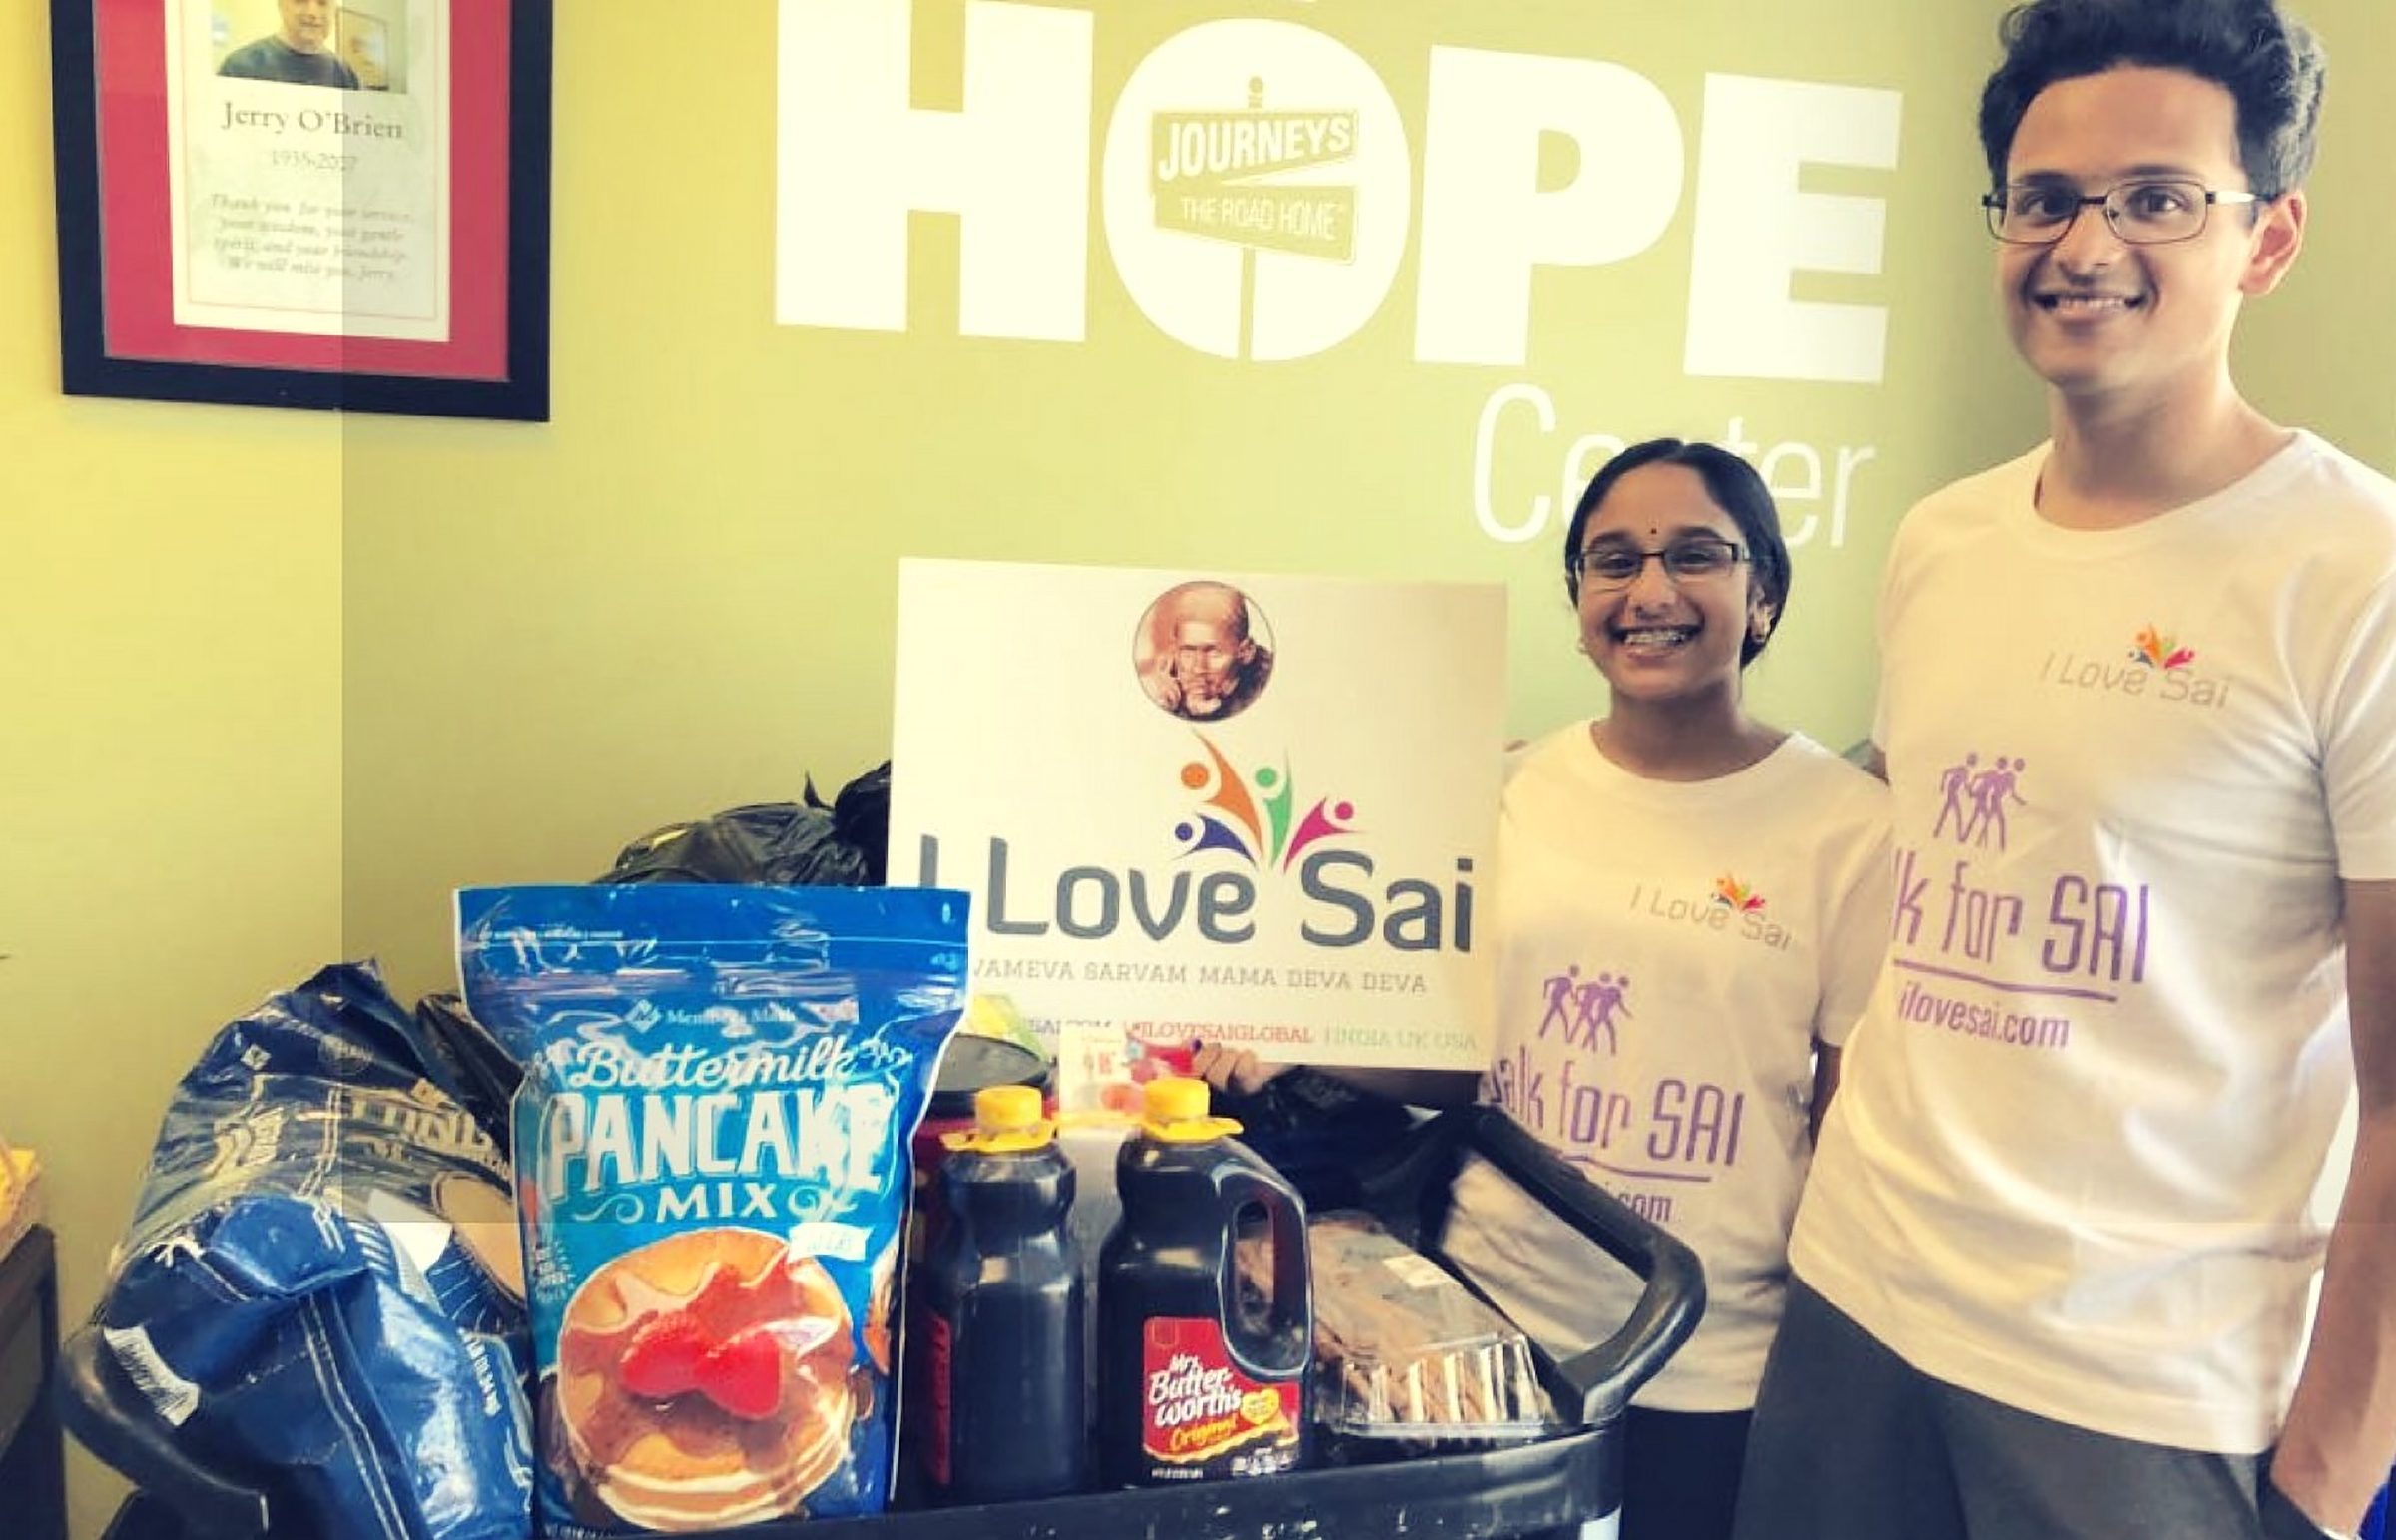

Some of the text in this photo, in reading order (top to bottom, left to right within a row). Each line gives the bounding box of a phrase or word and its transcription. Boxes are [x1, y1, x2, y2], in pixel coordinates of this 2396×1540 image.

[221, 101, 403, 139] Jerry O'Brien
[1157, 115, 1351, 182] JOURNEYS
[774, 0, 1903, 384] HOPE
[1180, 196, 1338, 241] THE ROAD HOME
[2040, 652, 2229, 709] I Love Sai
[986, 836, 1256, 944] Love
[1300, 849, 1474, 953] Sai
[1630, 887, 1793, 950] I Love Sai
[1942, 860, 2023, 963] for
[2042, 875, 2149, 983] SAI
[1084, 961, 1187, 984] SARVAM
[1199, 965, 1277, 988] MAMA
[1287, 969, 1351, 991] DEVA
[1363, 971, 1428, 994] DEVA
[1898, 980, 2070, 1047] ilovesai.com
[571, 1035, 857, 1088] Buttermilk
[550, 1082, 894, 1200] PANCAKE
[1558, 1059, 1632, 1149] for
[1646, 1078, 1745, 1166] SAI
[655, 1182, 778, 1223] MIX
[1170, 1413, 1237, 1451] Original
